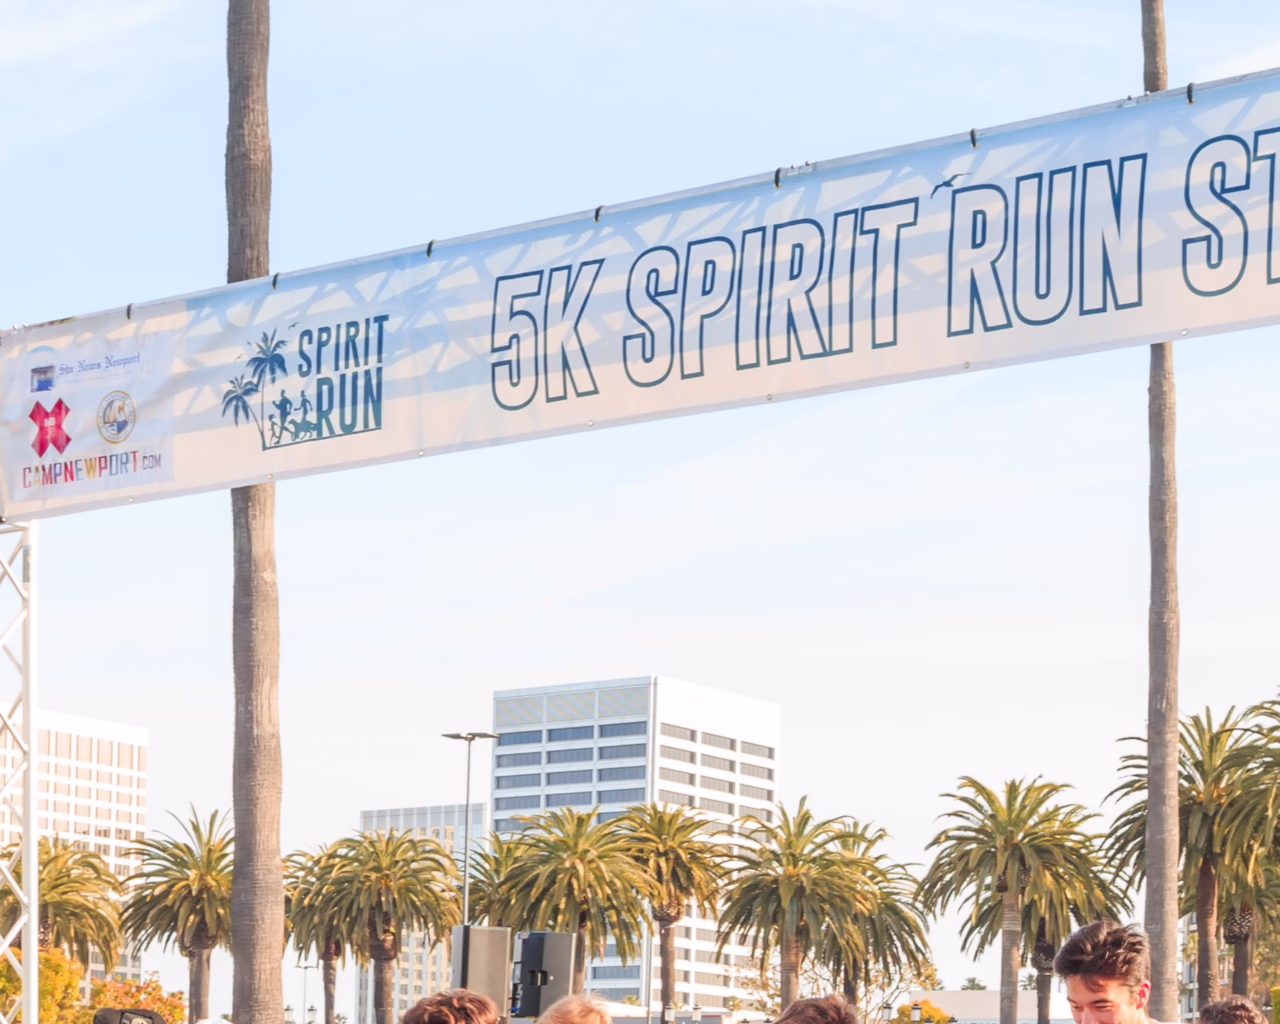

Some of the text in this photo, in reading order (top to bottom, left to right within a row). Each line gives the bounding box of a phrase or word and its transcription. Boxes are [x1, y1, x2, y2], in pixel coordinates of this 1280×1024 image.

[491, 257, 606, 411] 5K
[622, 197, 920, 388] SPIRIT
[947, 152, 1148, 338] RUN
[78, 359, 101, 373] News
[104, 353, 140, 369] Newport
[298, 314, 389, 378] SPIRIT
[316, 366, 383, 438] RUN
[23, 450, 161, 488] CAMPNEWPORT.COM
